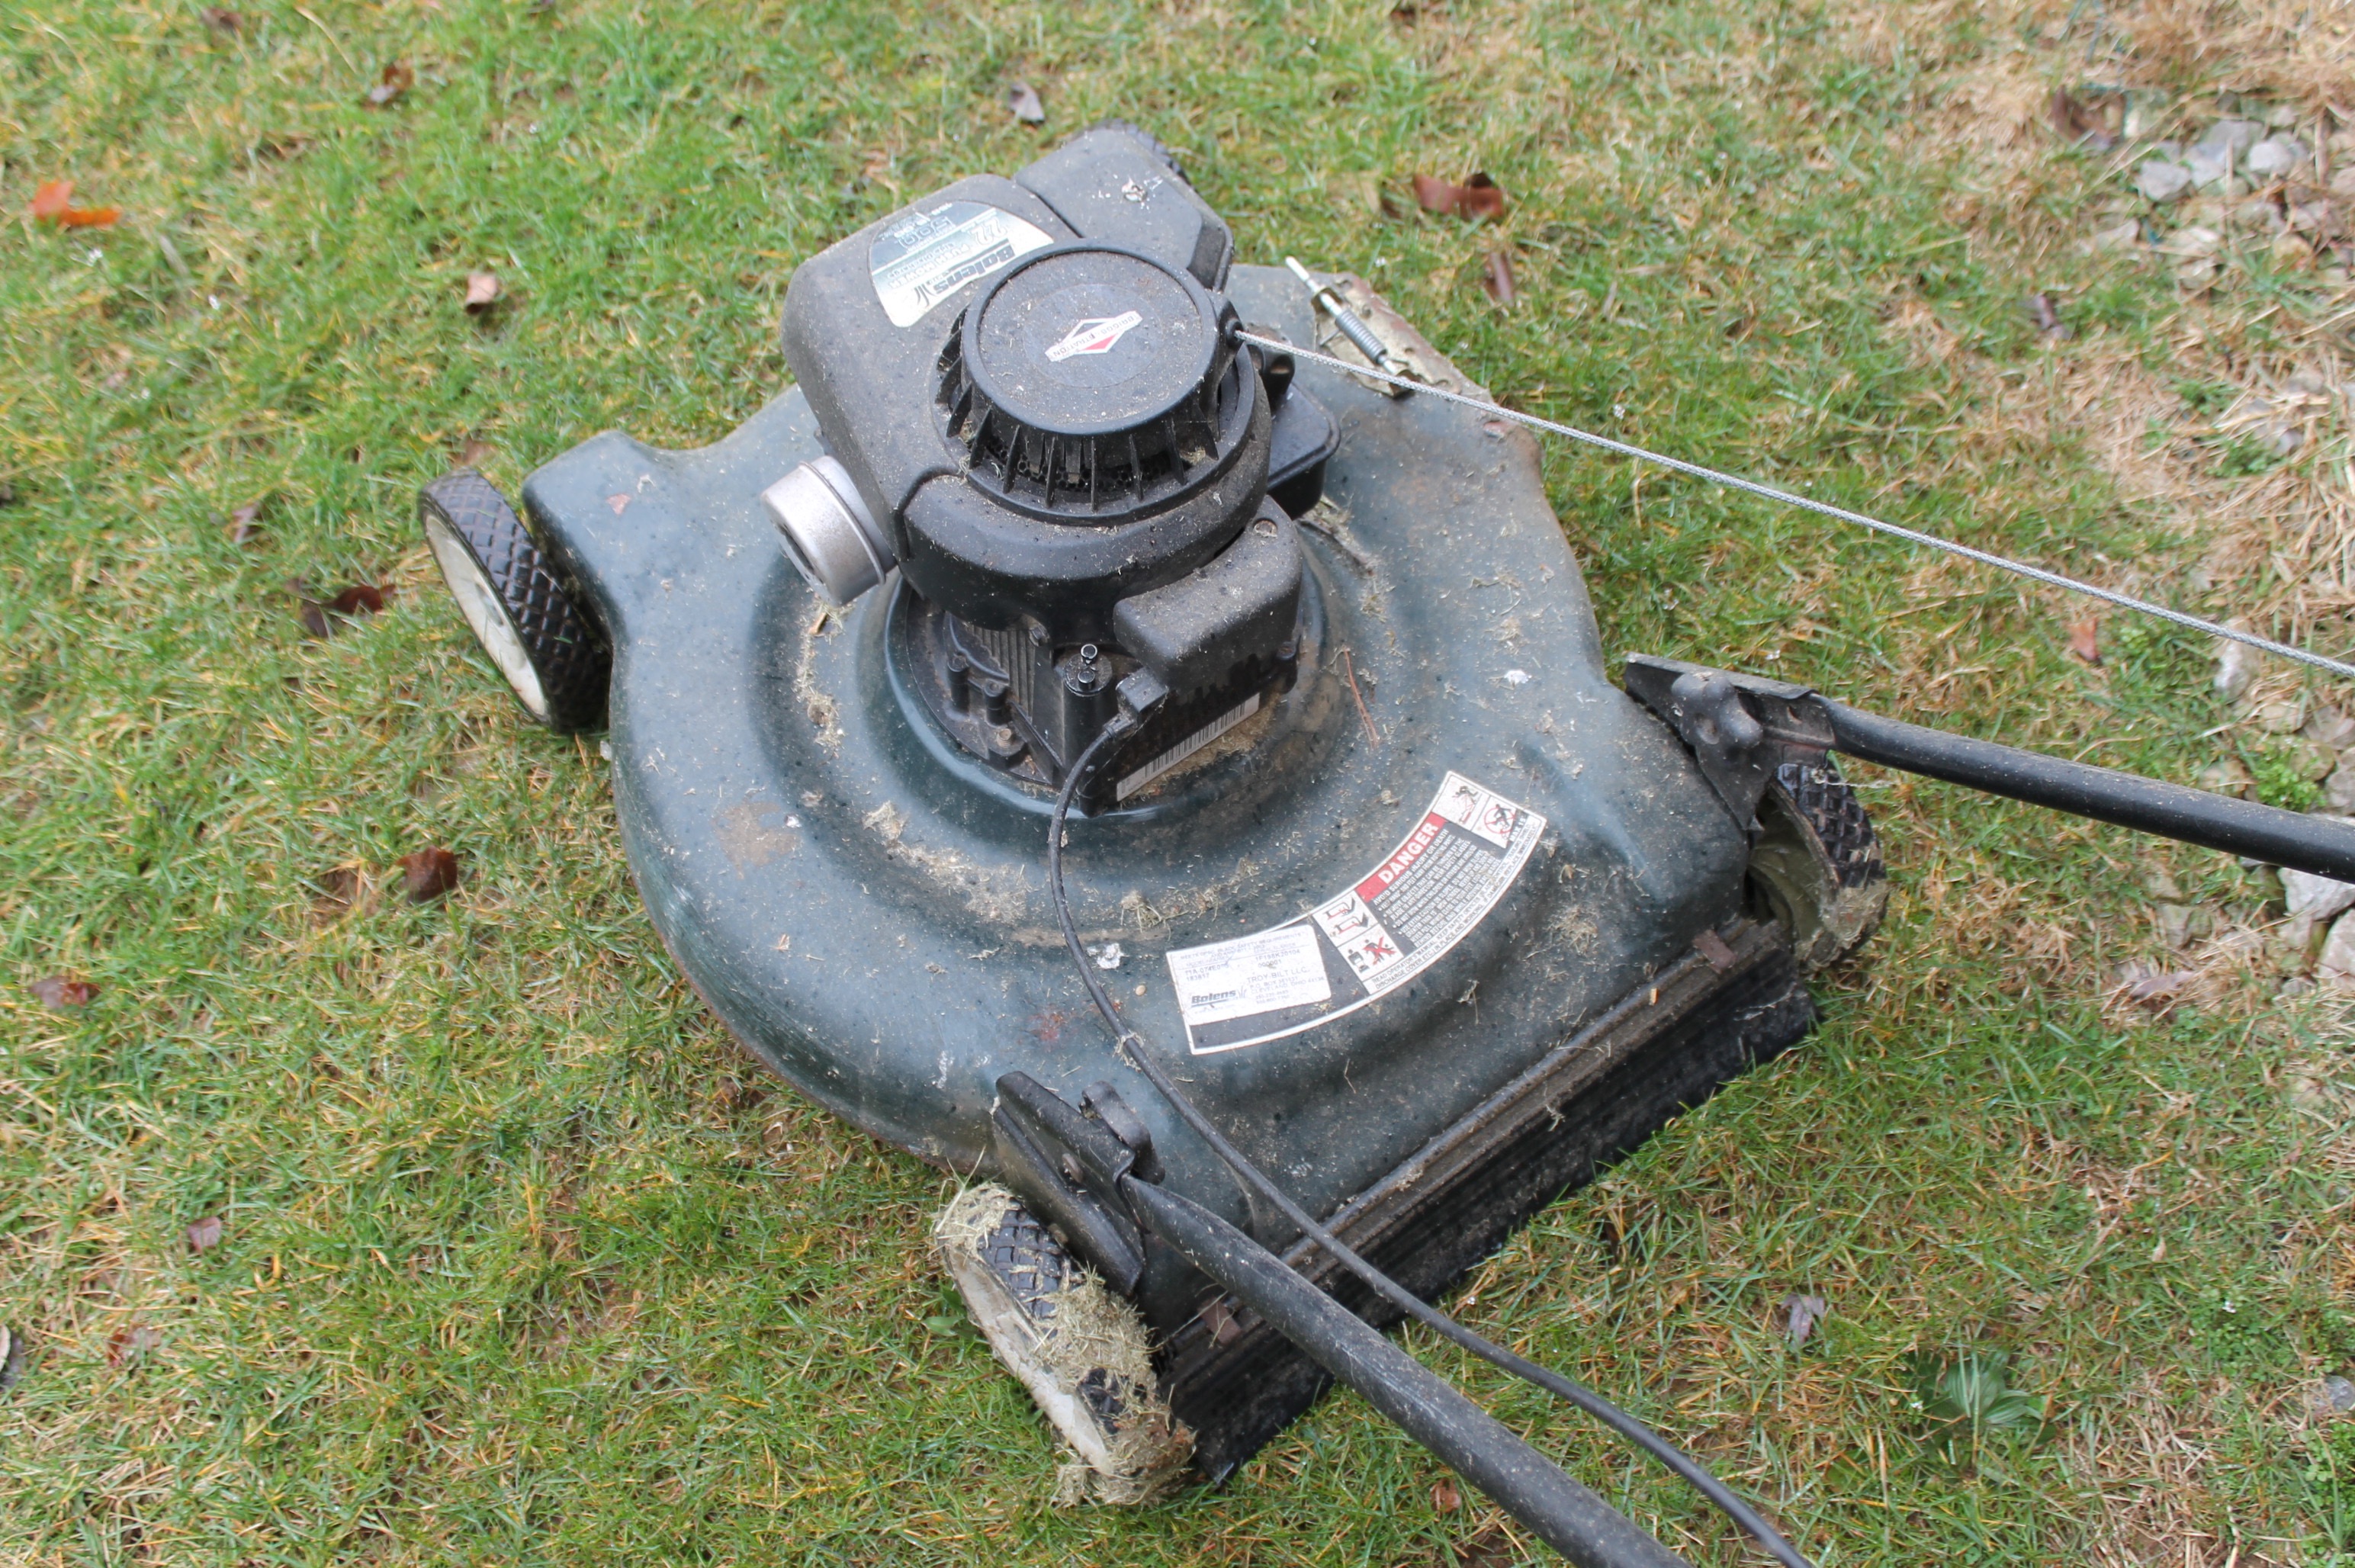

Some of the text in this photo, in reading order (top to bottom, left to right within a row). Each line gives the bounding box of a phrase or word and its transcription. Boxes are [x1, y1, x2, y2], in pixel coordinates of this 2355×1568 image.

[896, 214, 955, 249] 500
[970, 214, 1007, 249] 22
[888, 243, 969, 288] PUSH MOWER
[932, 243, 1015, 295] Bolens
[1100, 315, 1134, 335] BRIGGS
[1377, 818, 1439, 885] DANGER
[1508, 825, 1521, 842] MAX
[1372, 827, 1449, 906] AVOID SERIOUS INJURY OR DEATH
[1386, 900, 1403, 916] REMOVE
[1400, 885, 1419, 903] OBJECTS
[1416, 876, 1428, 888] THAT
[1425, 869, 1435, 880] CAN
[1431, 863, 1440, 872] BE
[1451, 843, 1458, 853] BY
[1455, 837, 1464, 847] THE
[1390, 907, 1405, 921] BLADE
[1406, 895, 1417, 906] ANY
[1433, 867, 1446, 881] WEAR
[1442, 855, 1457, 871] SAFETY
[1406, 876, 1417, 886] FEET
[1371, 972, 1387, 984] READ
[1435, 927, 1449, 940] KEEP
[1447, 913, 1464, 930] SAFETY
[1463, 896, 1480, 914] DEVICES
[1491, 860, 1508, 882] ONTROL,
[1375, 969, 1406, 989] DISCHARGE
[1404, 957, 1422, 972] COVER
[1439, 931, 1455, 946] PLACE
[1453, 922, 1464, 933] AND
[1503, 853, 1519, 876] REPLACE
[1399, 913, 1409, 922] NOT
[1415, 895, 1428, 908] WHEN
[1425, 881, 1444, 899] CHILDREN
[1405, 921, 1423, 939] GREATER
[1420, 913, 1432, 925] THAN
[1457, 874, 1471, 888] NEVER
[1473, 862, 1482, 872] AND
[1407, 914, 1422, 927] EXTRA
[1418, 900, 1436, 917] CAUTION
[1456, 870, 1465, 880] NOT
[1409, 930, 1424, 943] NEVER
[1420, 923, 1432, 934] PULL
[1441, 901, 1454, 915] CLOSE
[1455, 889, 1467, 901] YOUR
[1414, 932, 1431, 949] BEHIND
[1429, 918, 1447, 935] BEFORE
[1444, 910, 1456, 921] AND
[1454, 898, 1468, 913] WHILE
[1465, 882, 1482, 901] MOVING
[1258, 932, 1300, 944] REQUIREMENTS
[1190, 989, 1236, 1004] Bolens
